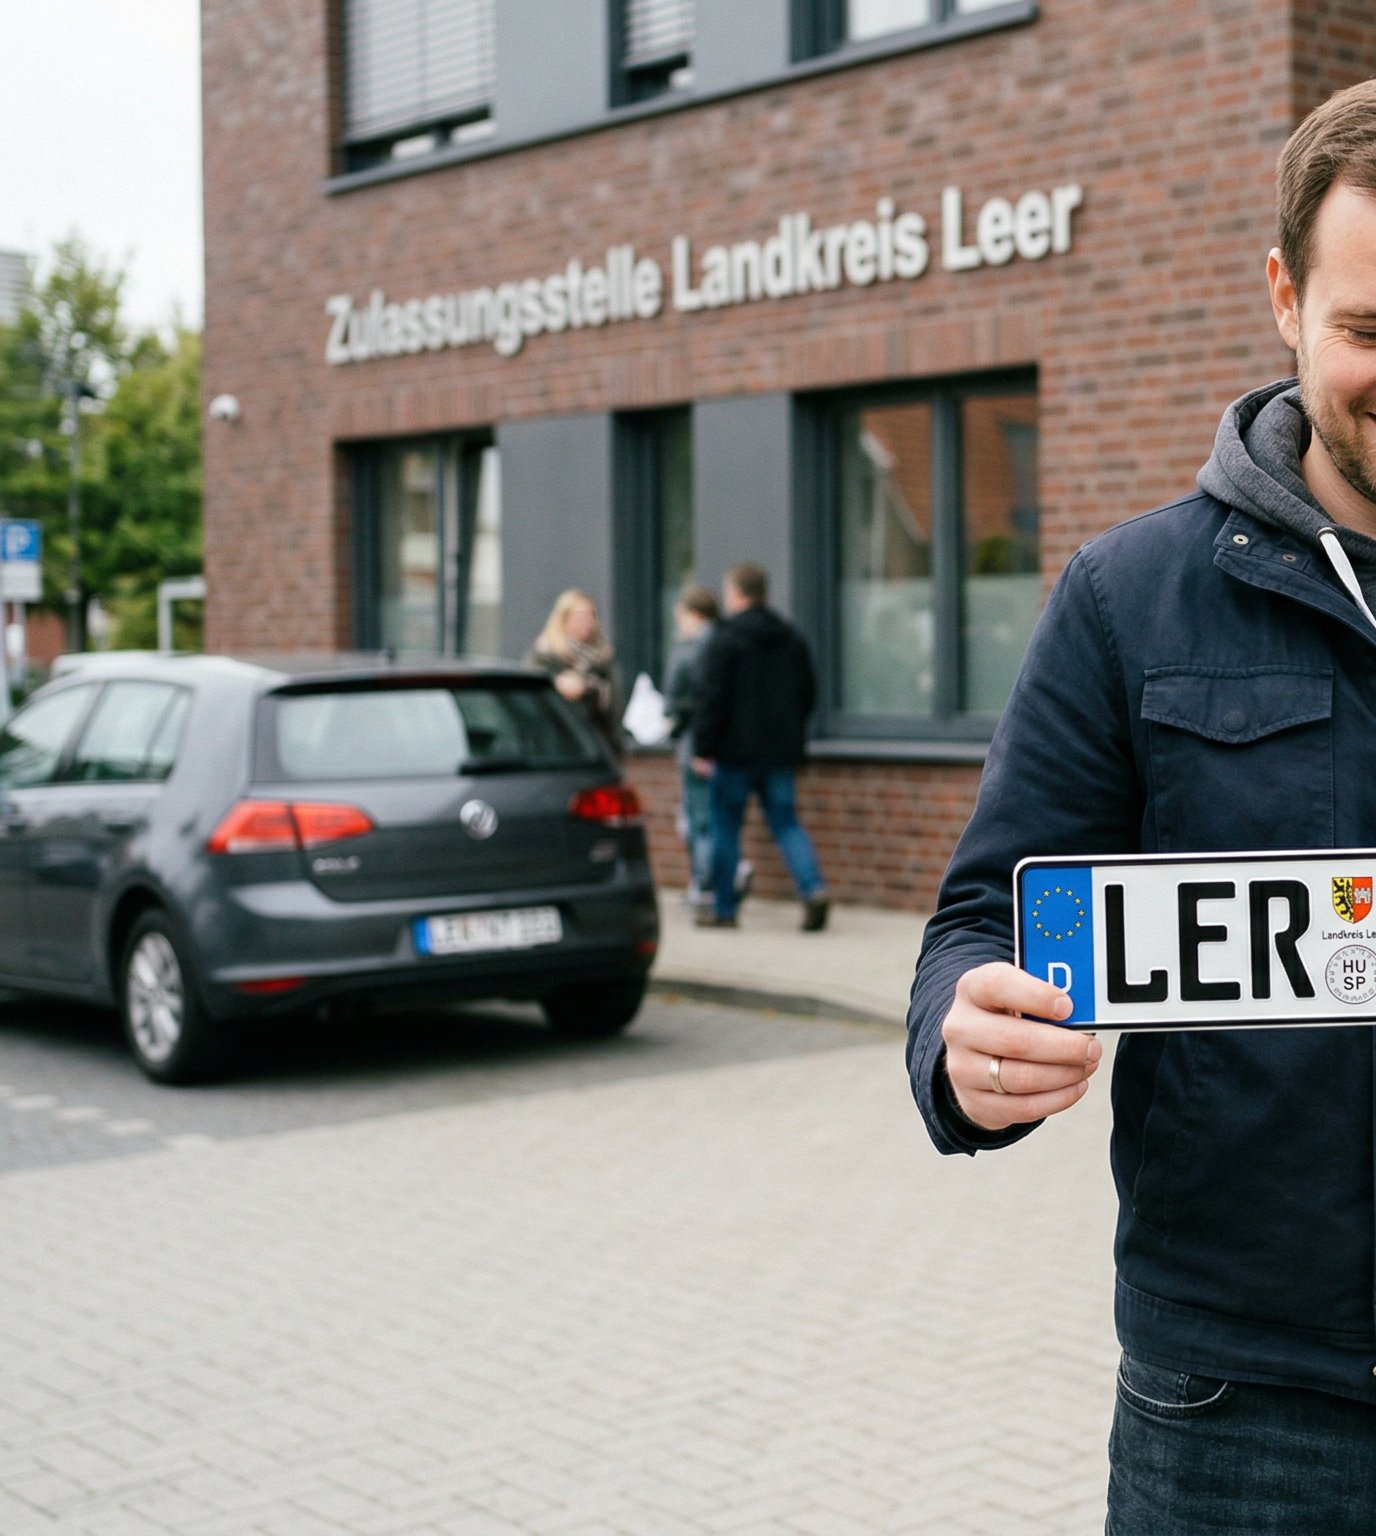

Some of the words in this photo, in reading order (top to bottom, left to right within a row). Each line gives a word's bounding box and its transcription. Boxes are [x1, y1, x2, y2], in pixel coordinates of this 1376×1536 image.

[326, 245, 663, 364] Zulassungsstelle
[672, 196, 929, 312] Landkreis
[941, 184, 1082, 272] Leer
[1104, 880, 1315, 1005] LER
[1322, 929, 1364, 940] Landkreis
[1047, 961, 1073, 993] D
[1342, 959, 1367, 974] HU
[1343, 975, 1367, 991] SP
